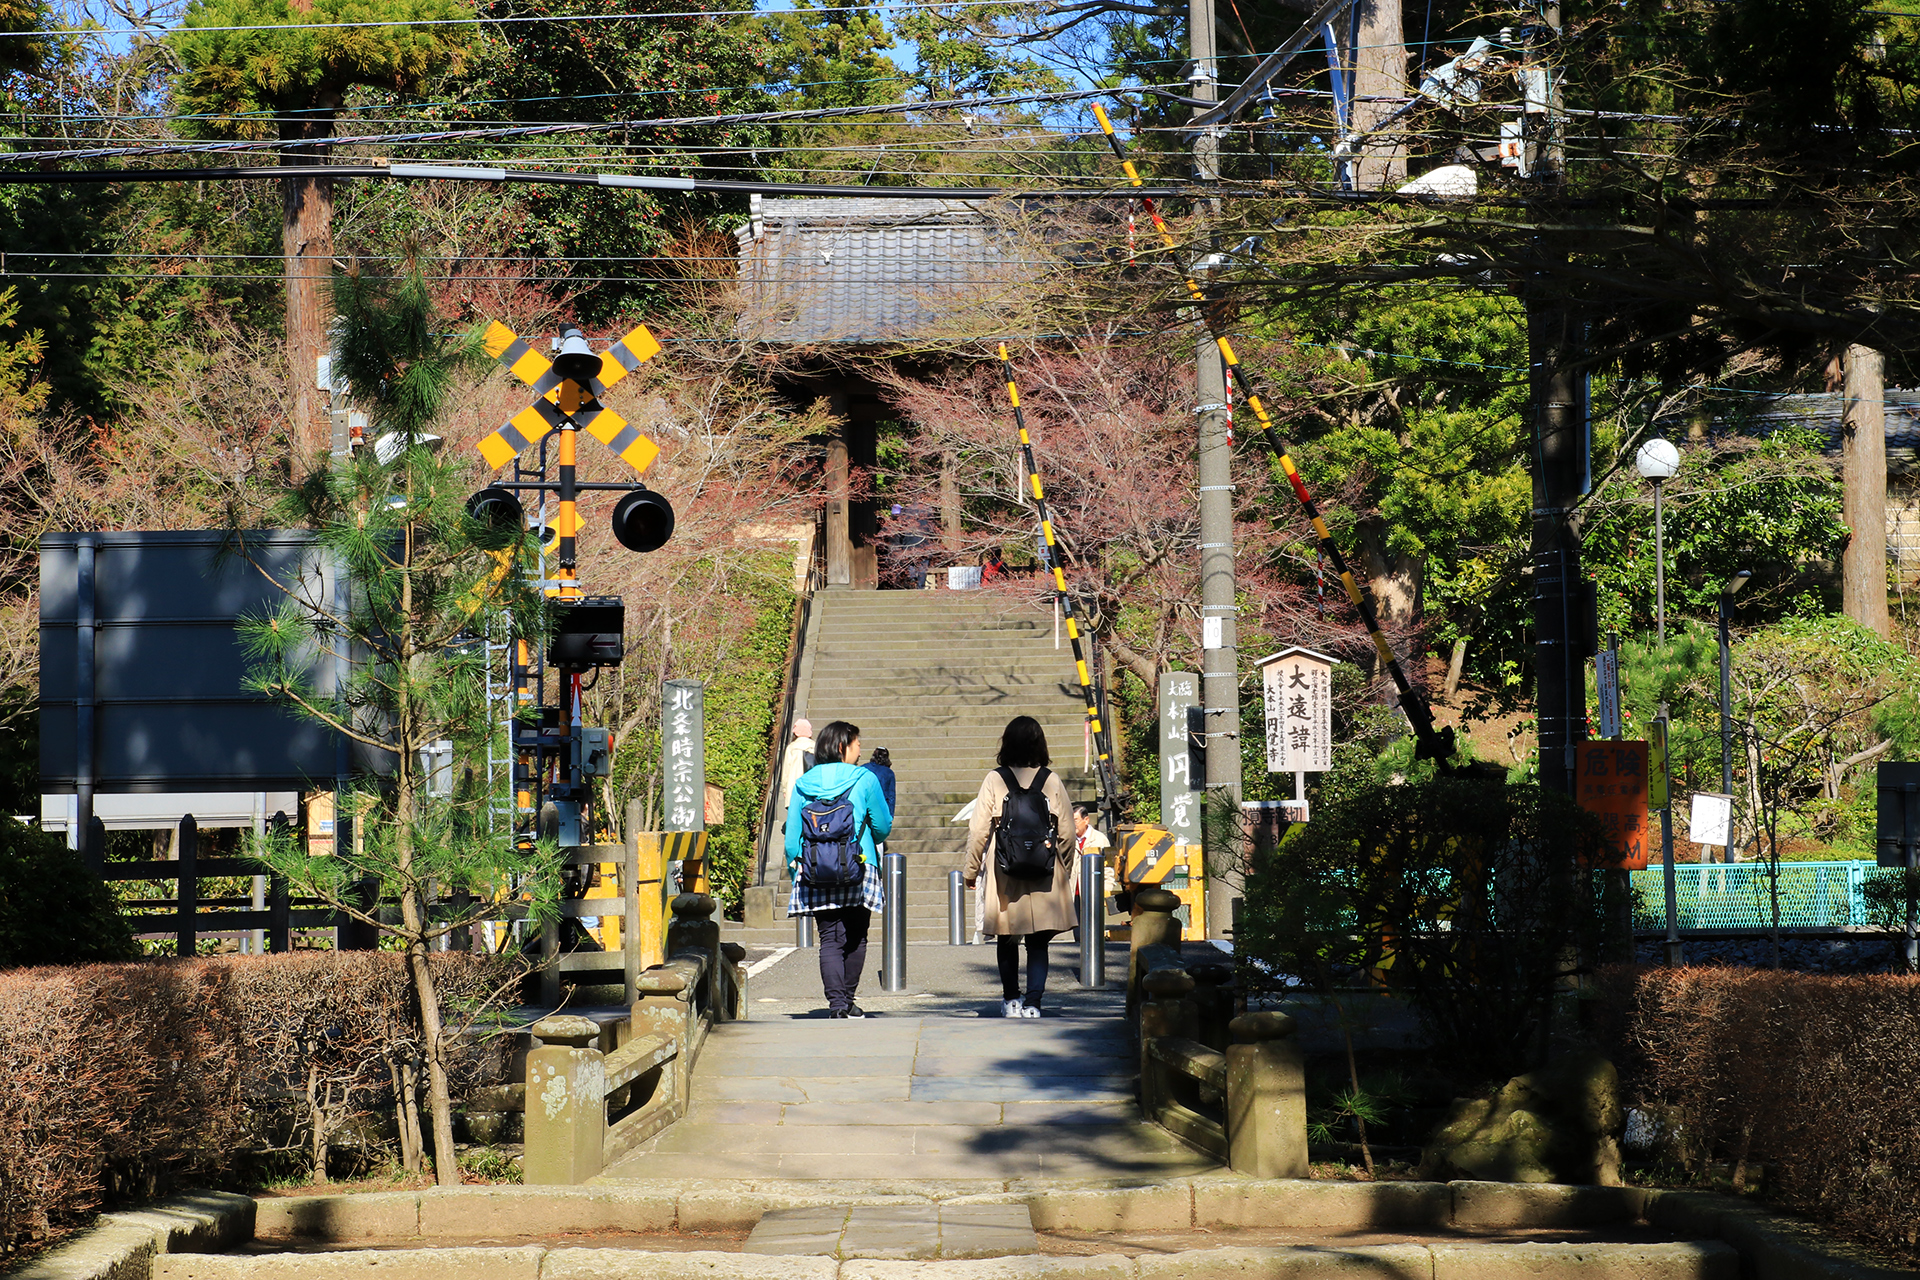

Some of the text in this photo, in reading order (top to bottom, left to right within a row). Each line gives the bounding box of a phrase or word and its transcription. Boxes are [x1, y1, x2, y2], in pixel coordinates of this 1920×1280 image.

[1287, 664, 1311, 753] 大遠諱
[671, 688, 696, 832] 北条時宗公御
[1584, 748, 1641, 777] 危険
[1596, 812, 1641, 833] 限高
